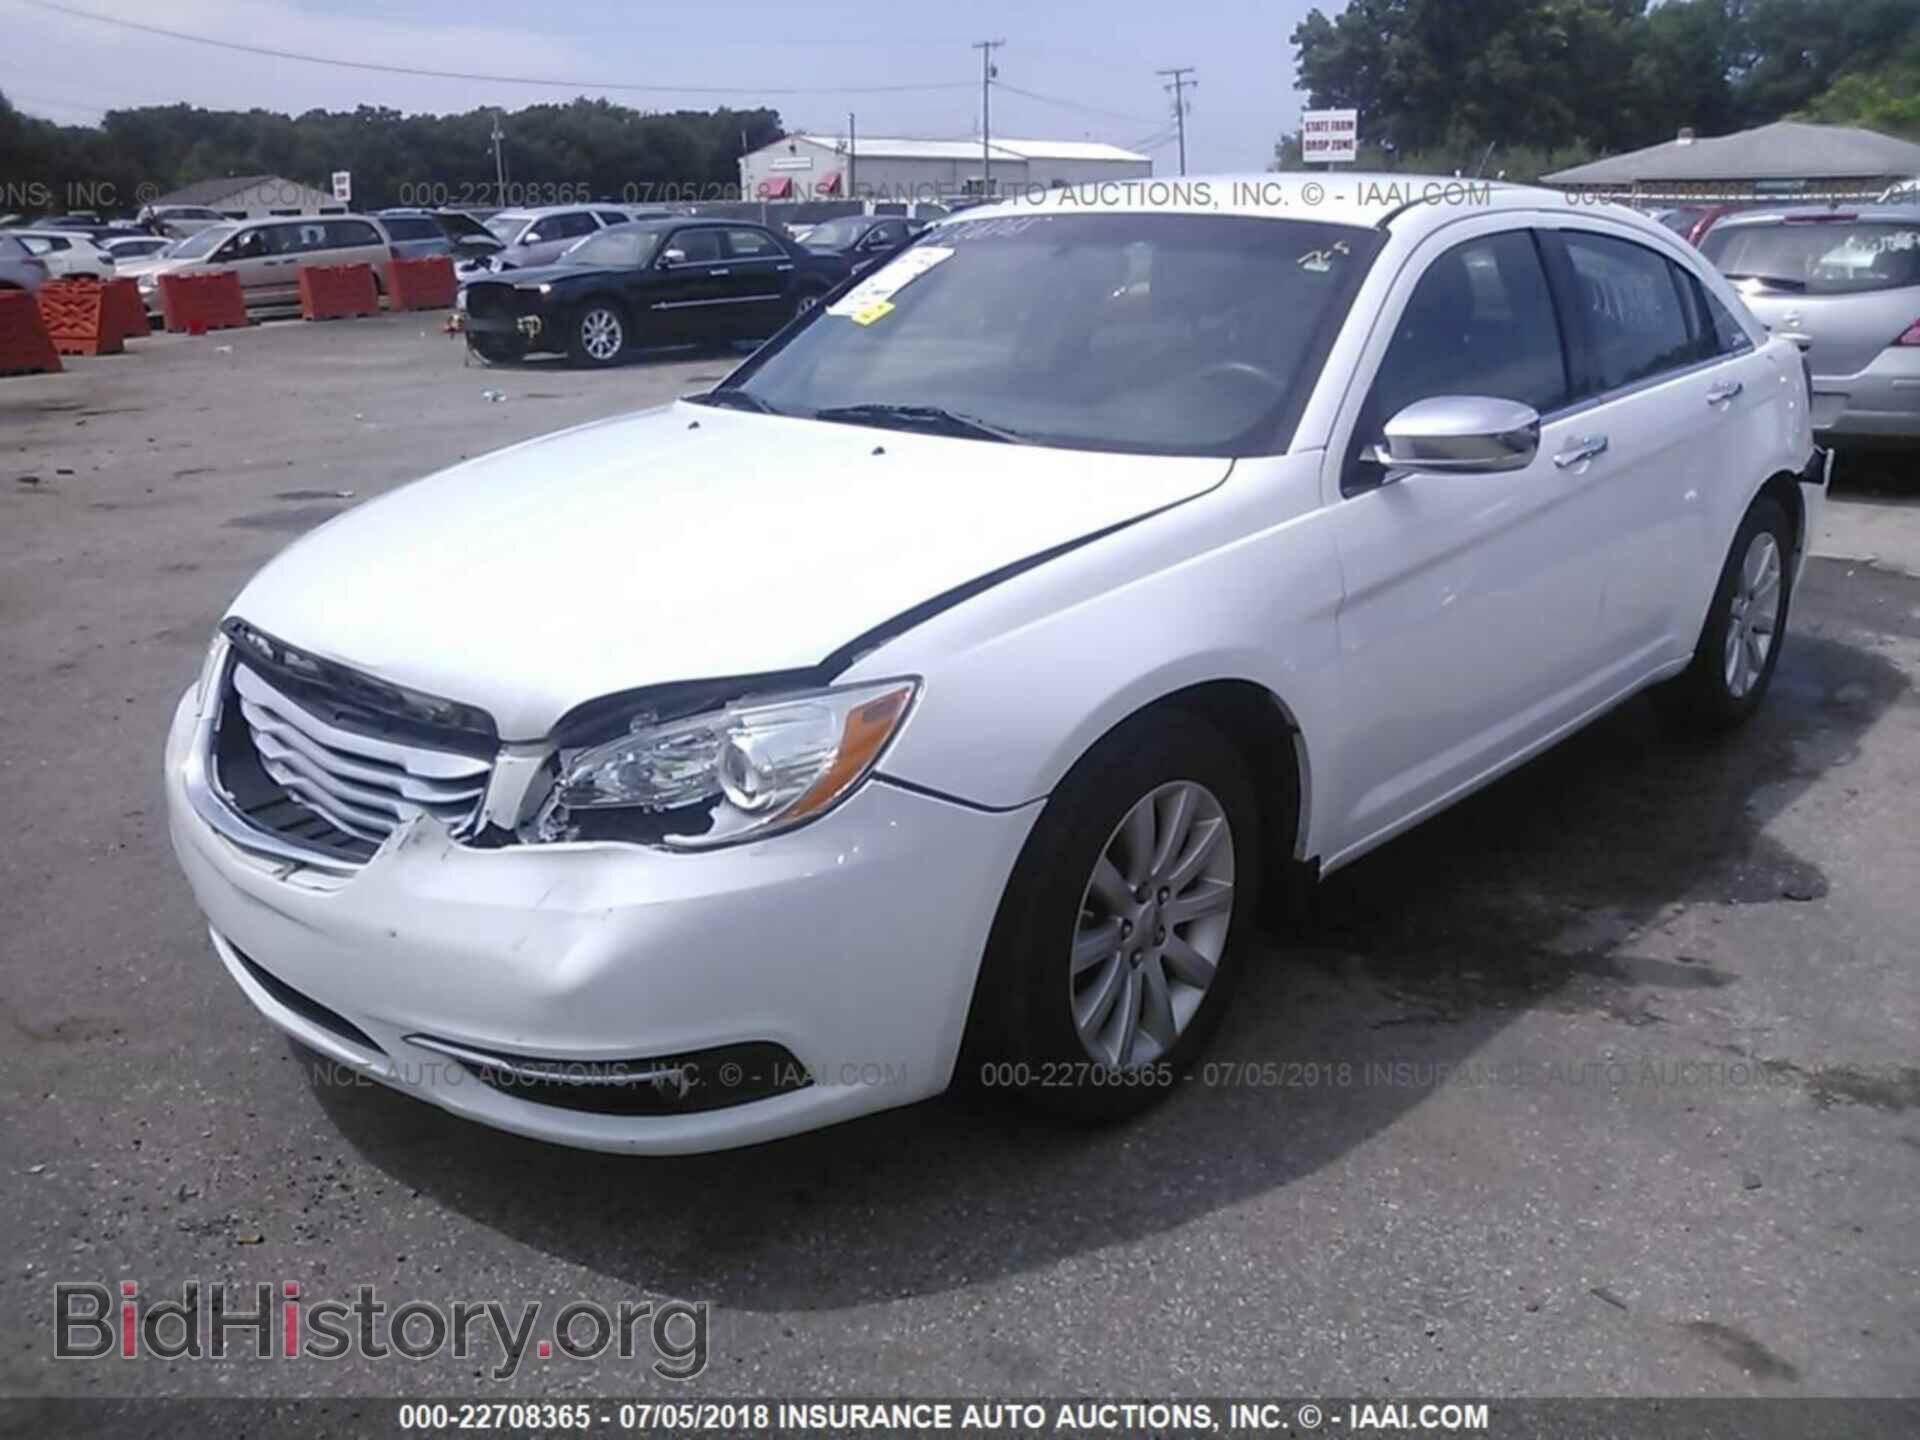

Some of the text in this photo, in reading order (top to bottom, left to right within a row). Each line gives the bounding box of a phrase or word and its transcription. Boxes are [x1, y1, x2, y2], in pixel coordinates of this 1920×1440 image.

[1305, 120, 1354, 132] STATE FARM
[1305, 139, 1353, 151] DROP ZONE
